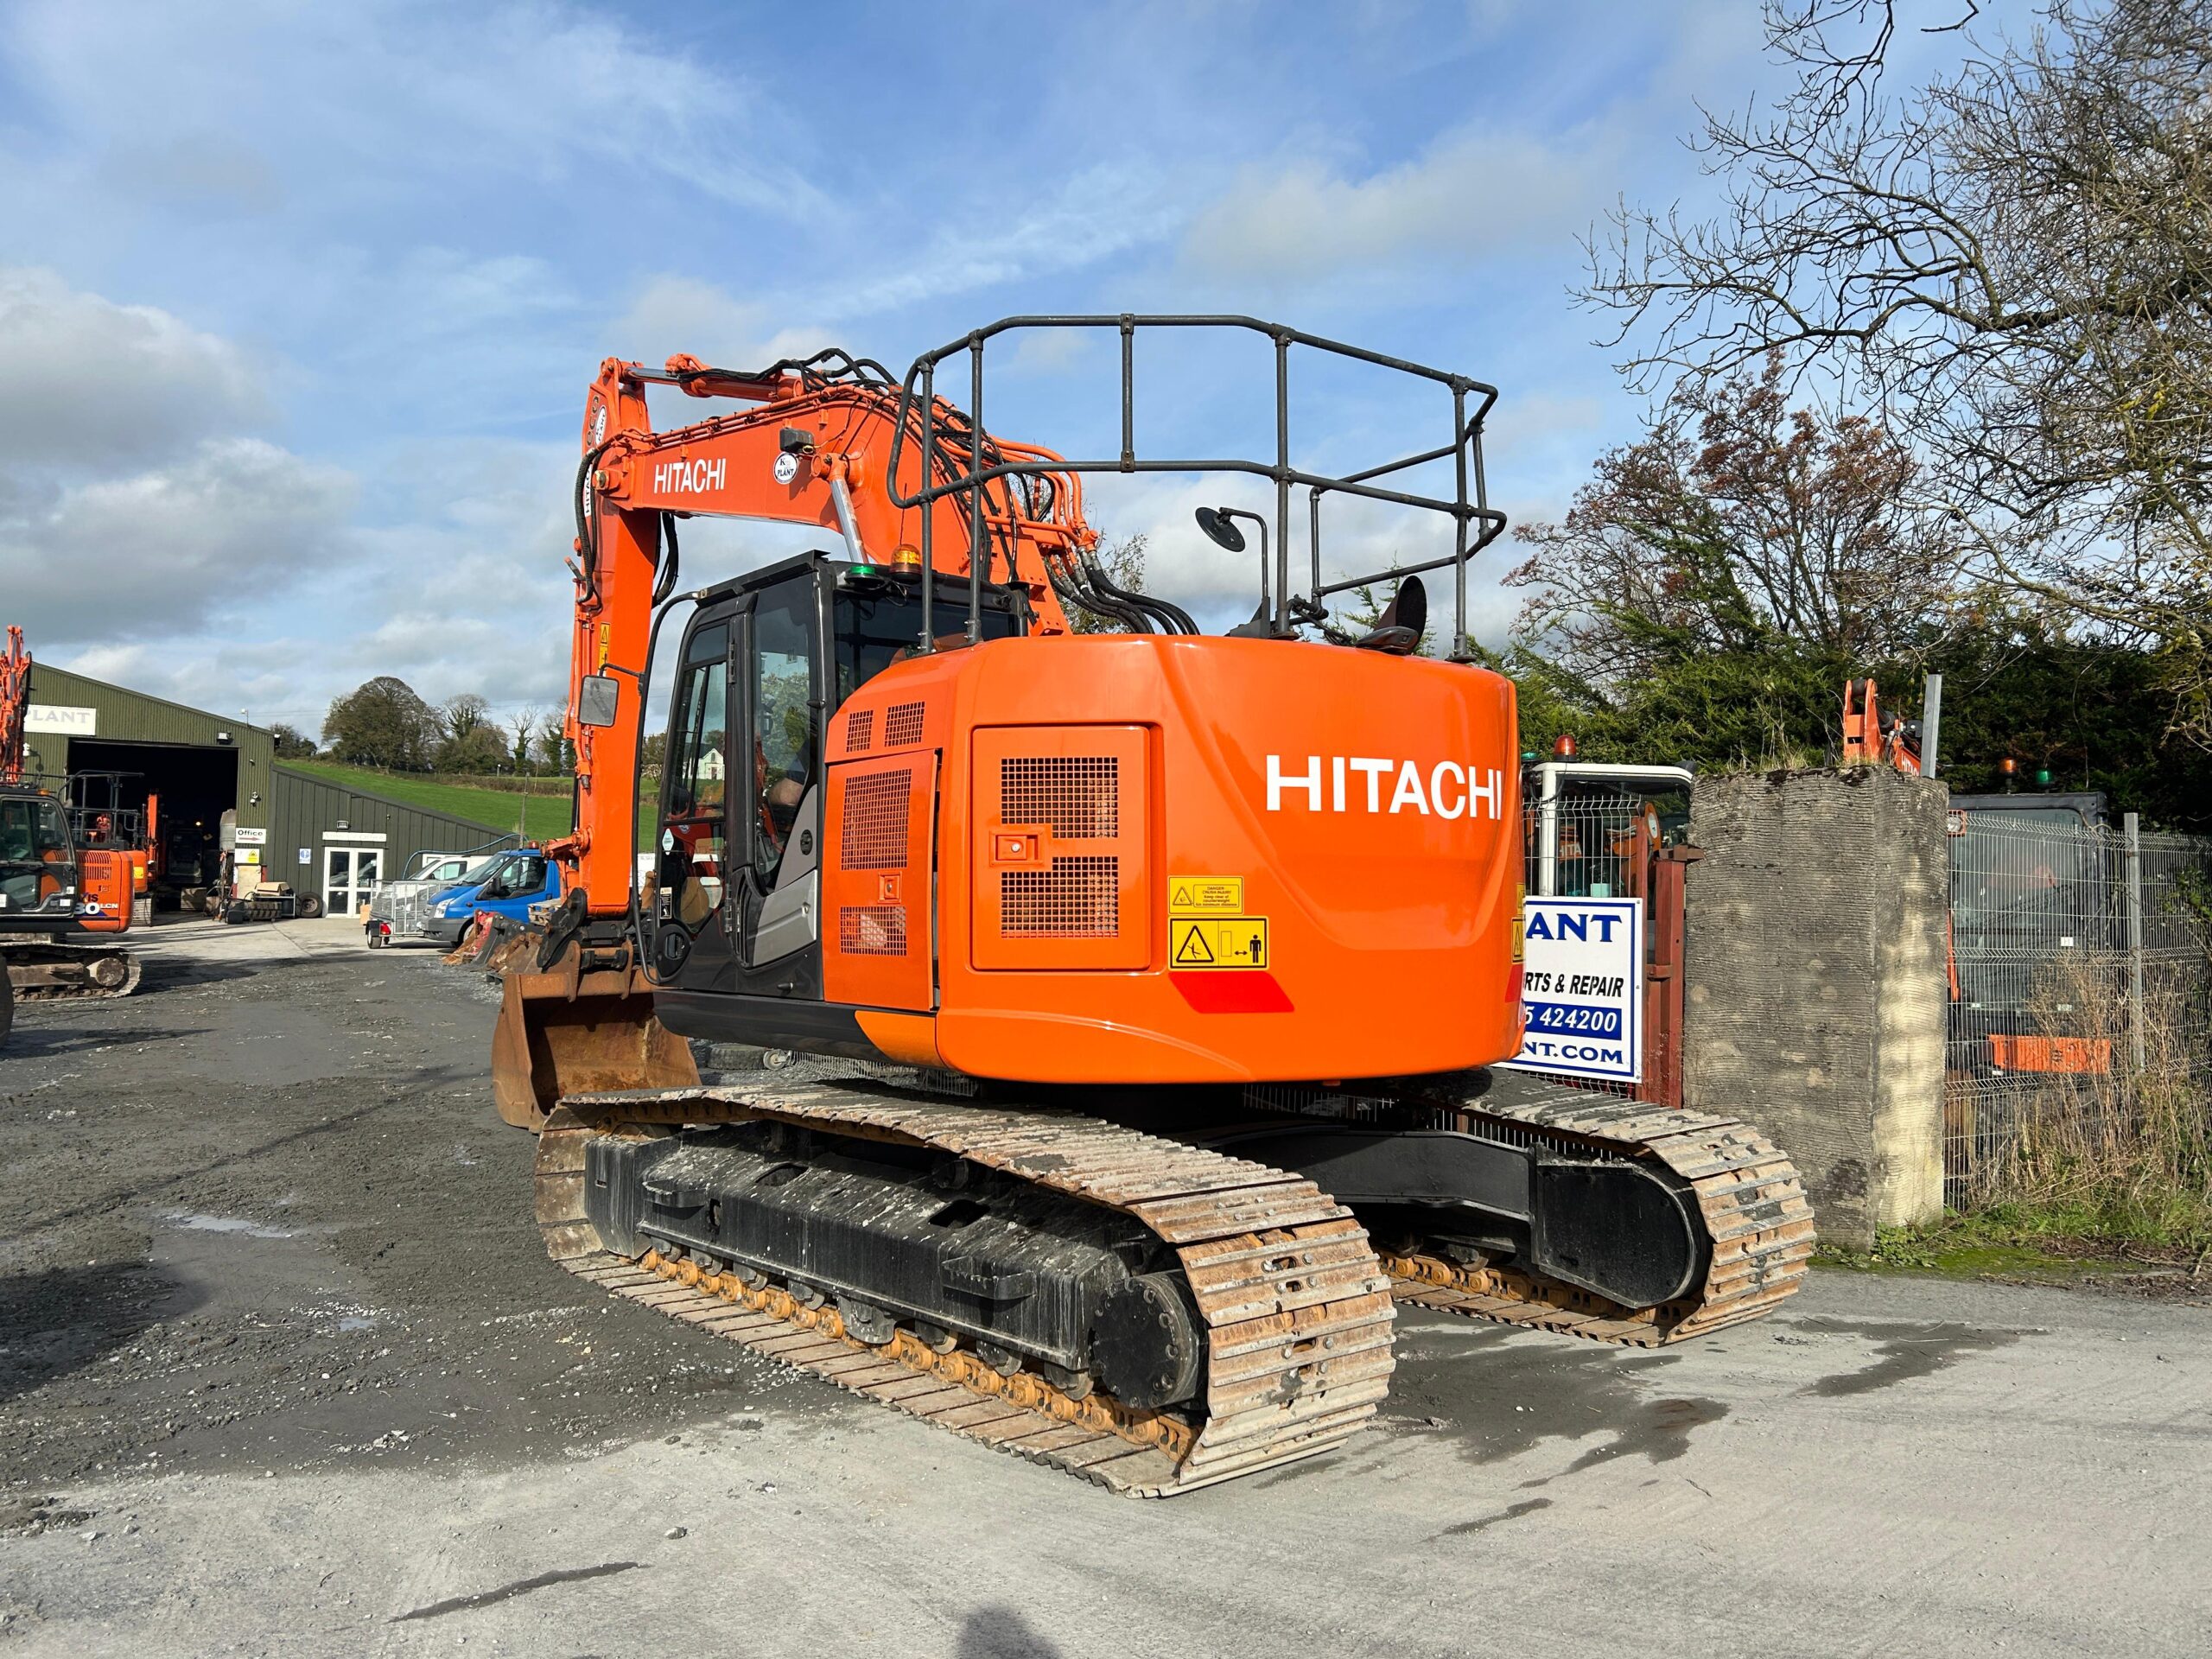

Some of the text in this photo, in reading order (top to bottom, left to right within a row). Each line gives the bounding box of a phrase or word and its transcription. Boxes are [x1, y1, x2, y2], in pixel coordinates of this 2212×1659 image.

[654, 458, 726, 493] HITACHI
[777, 468, 794, 477] PLANT
[1267, 754, 1502, 820] HITACHI
[1554, 974, 1565, 994] &
[1569, 975, 1624, 998] REPAIR
[1539, 1007, 1618, 1033] 424200
